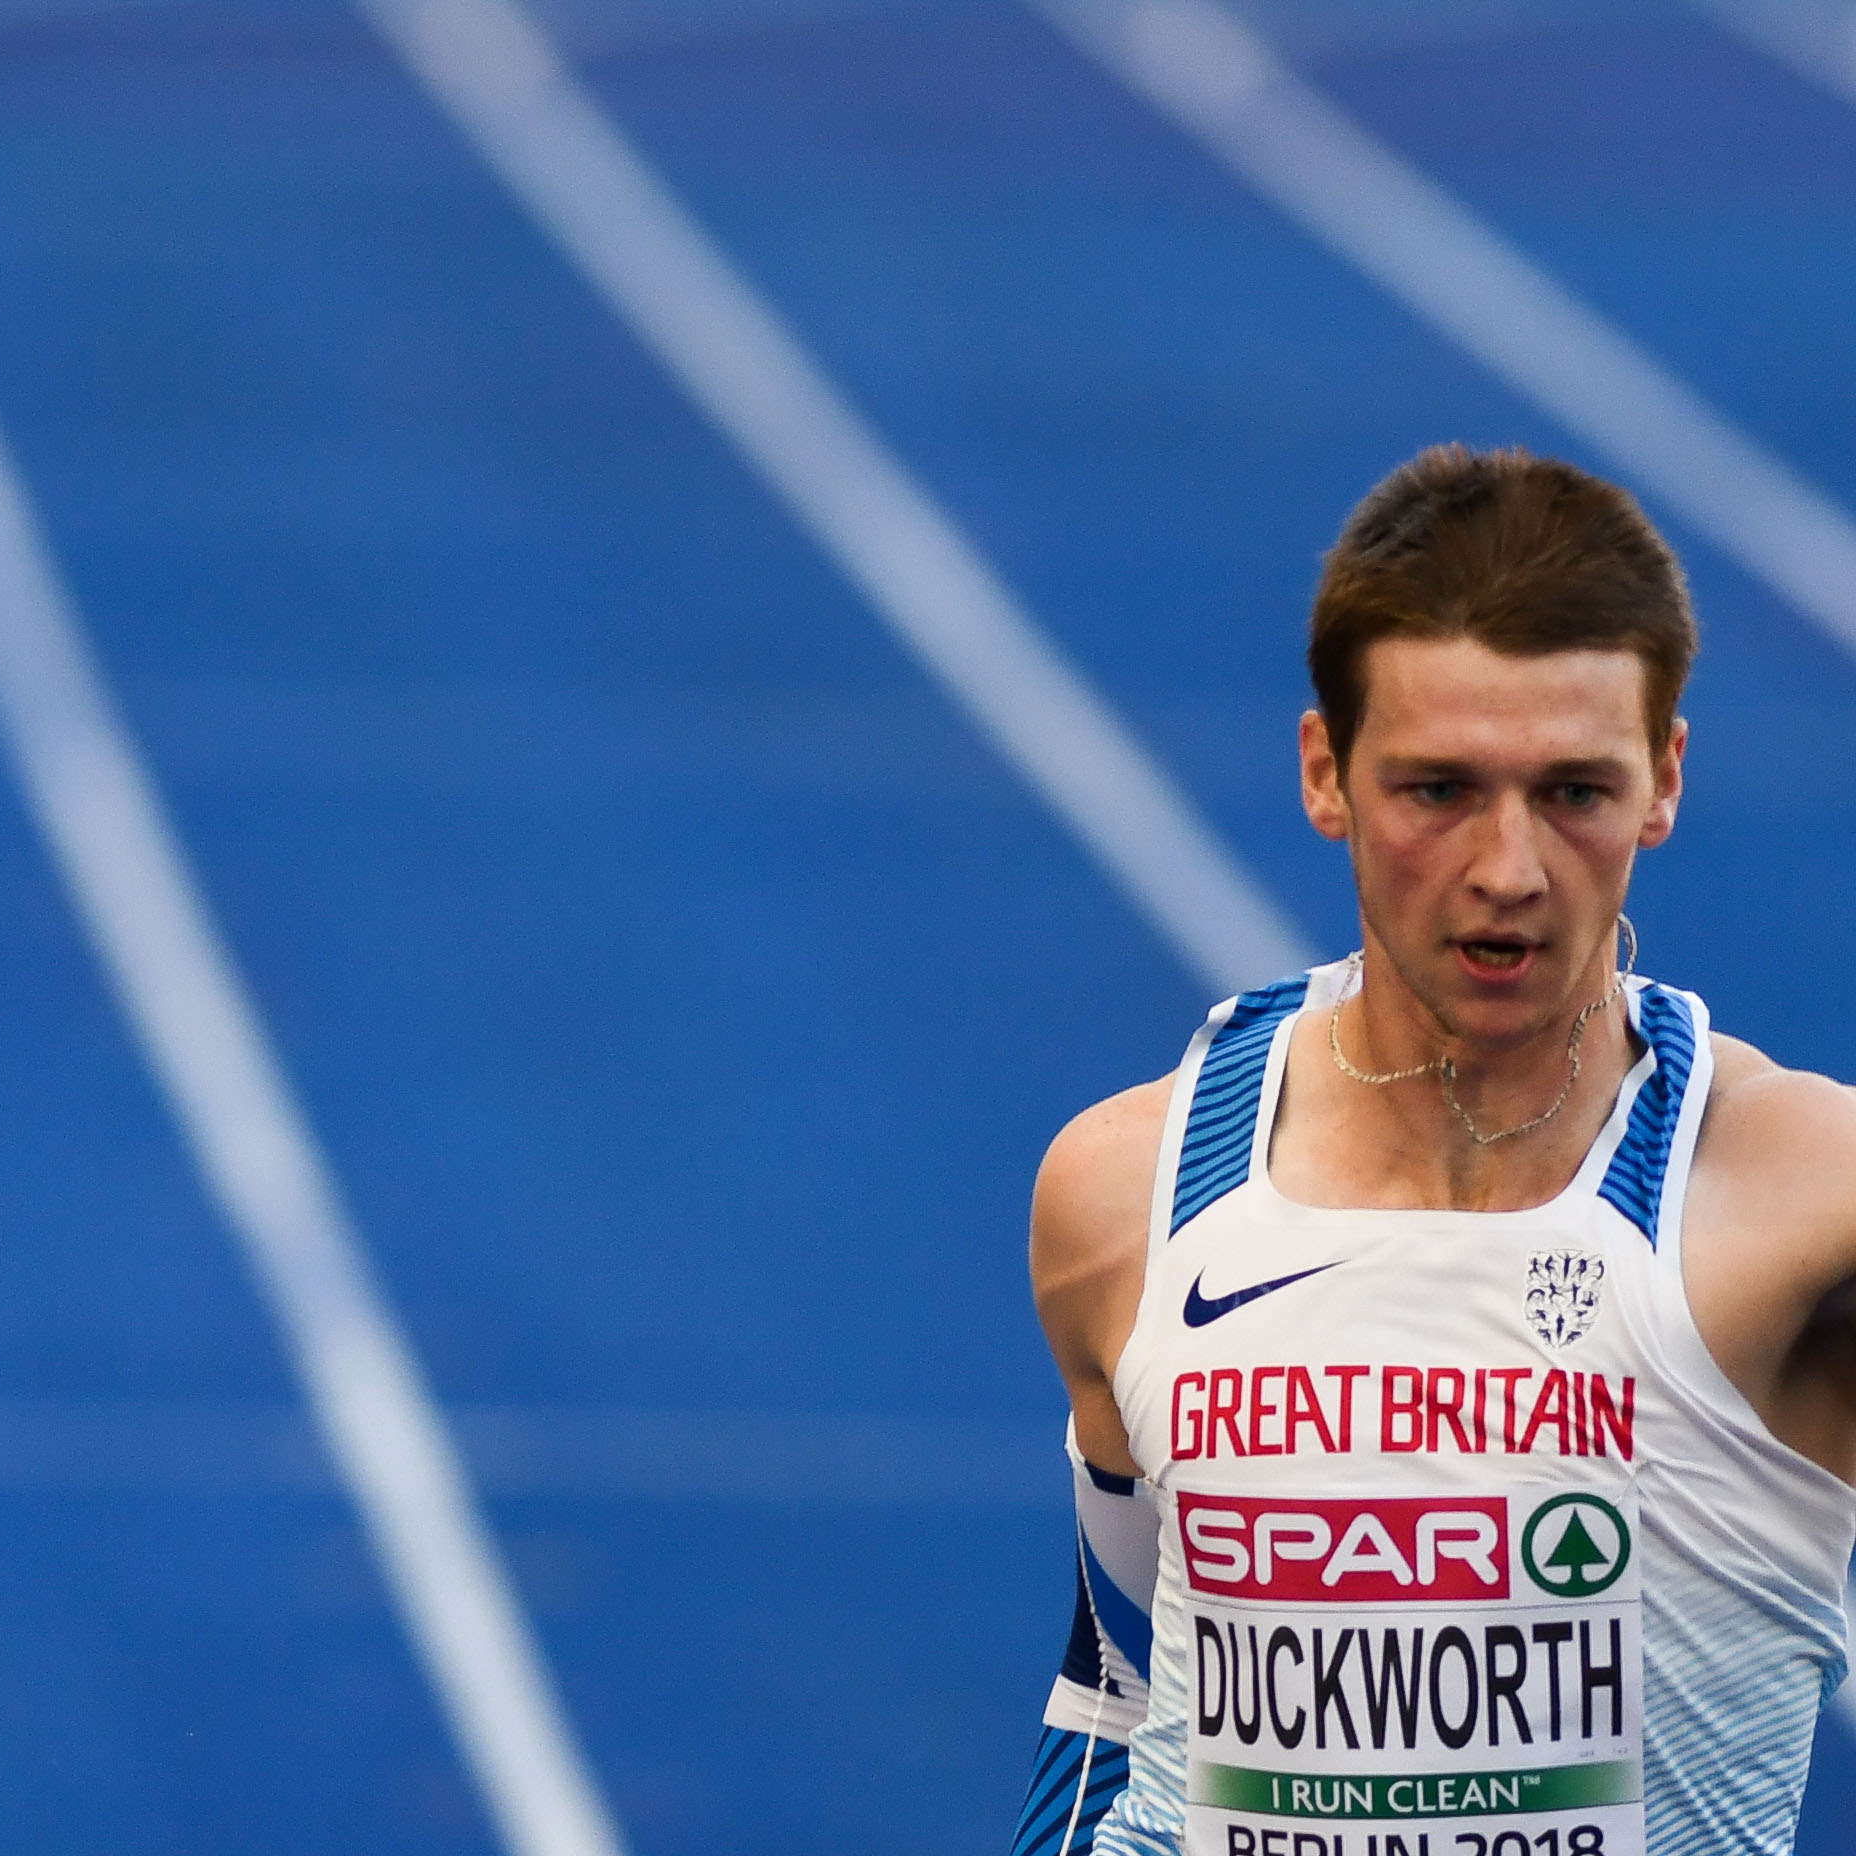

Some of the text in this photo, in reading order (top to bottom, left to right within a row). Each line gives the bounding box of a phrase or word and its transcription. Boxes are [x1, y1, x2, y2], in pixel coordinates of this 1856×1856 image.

[1171, 1365, 1636, 1463] GREAT BRITAIN
[1183, 1508, 1500, 1587] SPAR
[1195, 1615, 1623, 1751] DUCKWORTH
[1272, 1778, 1280, 1811] I
[1291, 1778, 1374, 1812] RUN
